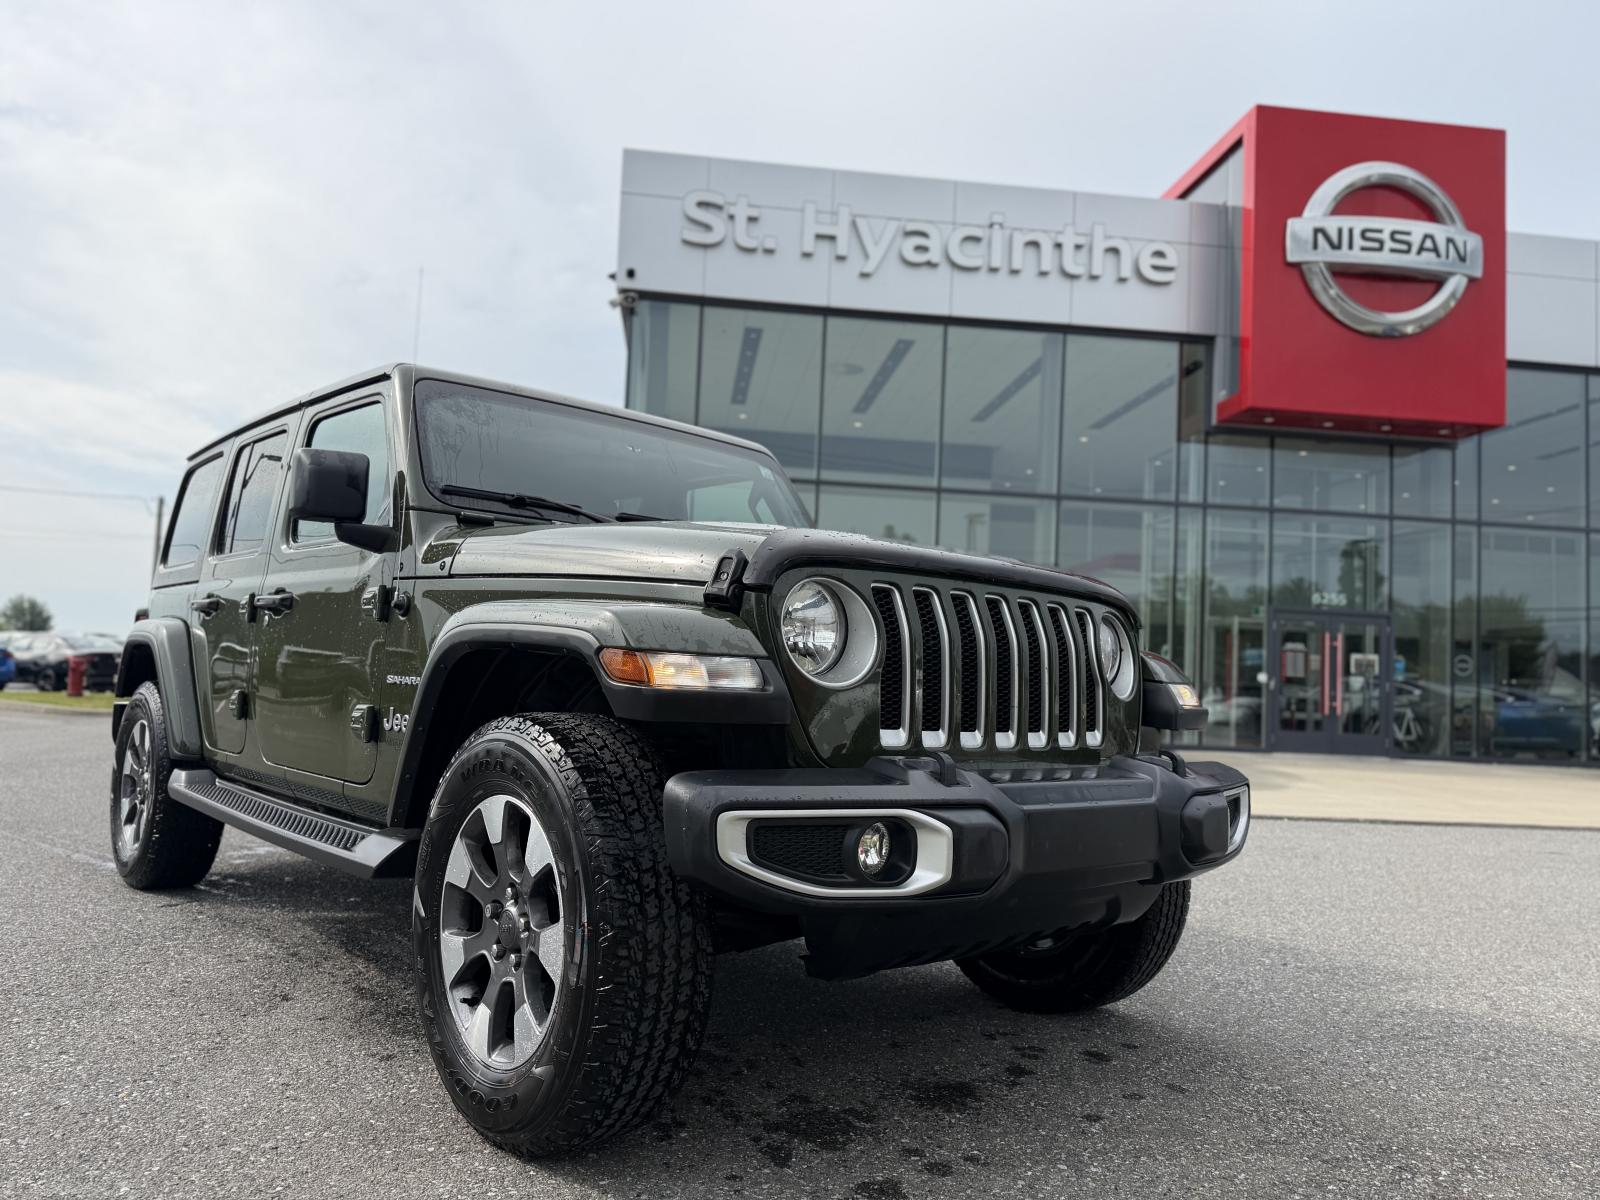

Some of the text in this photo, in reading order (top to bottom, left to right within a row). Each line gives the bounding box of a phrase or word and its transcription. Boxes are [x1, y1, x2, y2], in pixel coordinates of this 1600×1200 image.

[680, 189, 1178, 285] St. Hyacinthe
[1311, 227, 1468, 264] NISSAN
[386, 674, 421, 685] SAHARA
[383, 706, 410, 733] Jee
